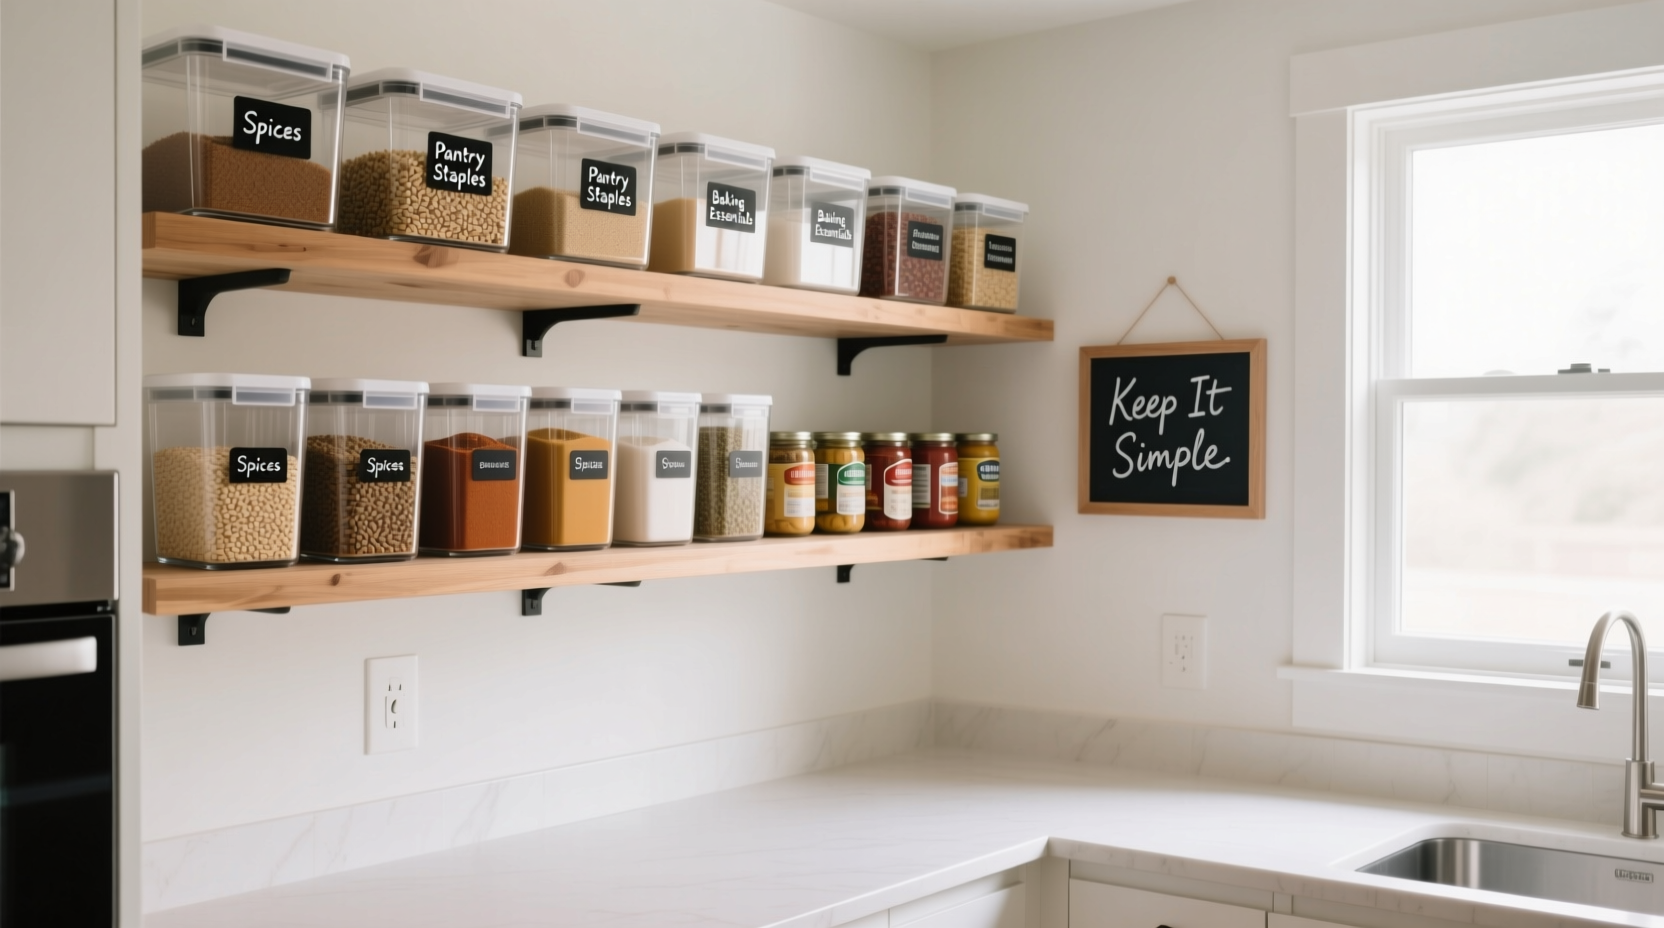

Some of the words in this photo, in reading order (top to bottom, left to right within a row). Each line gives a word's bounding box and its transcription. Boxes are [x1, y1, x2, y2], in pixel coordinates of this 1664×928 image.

[243, 110, 301, 144] Spices
[435, 141, 485, 171] Pantry
[433, 163, 486, 190] Staples
[589, 166, 629, 193] Pantry
[586, 186, 631, 210] Staples
[1109, 376, 1178, 436] Keep
[1187, 374, 1233, 418] It
[237, 455, 281, 478] Spices
[366, 457, 404, 478] Spices
[1112, 427, 1231, 488] Simple
